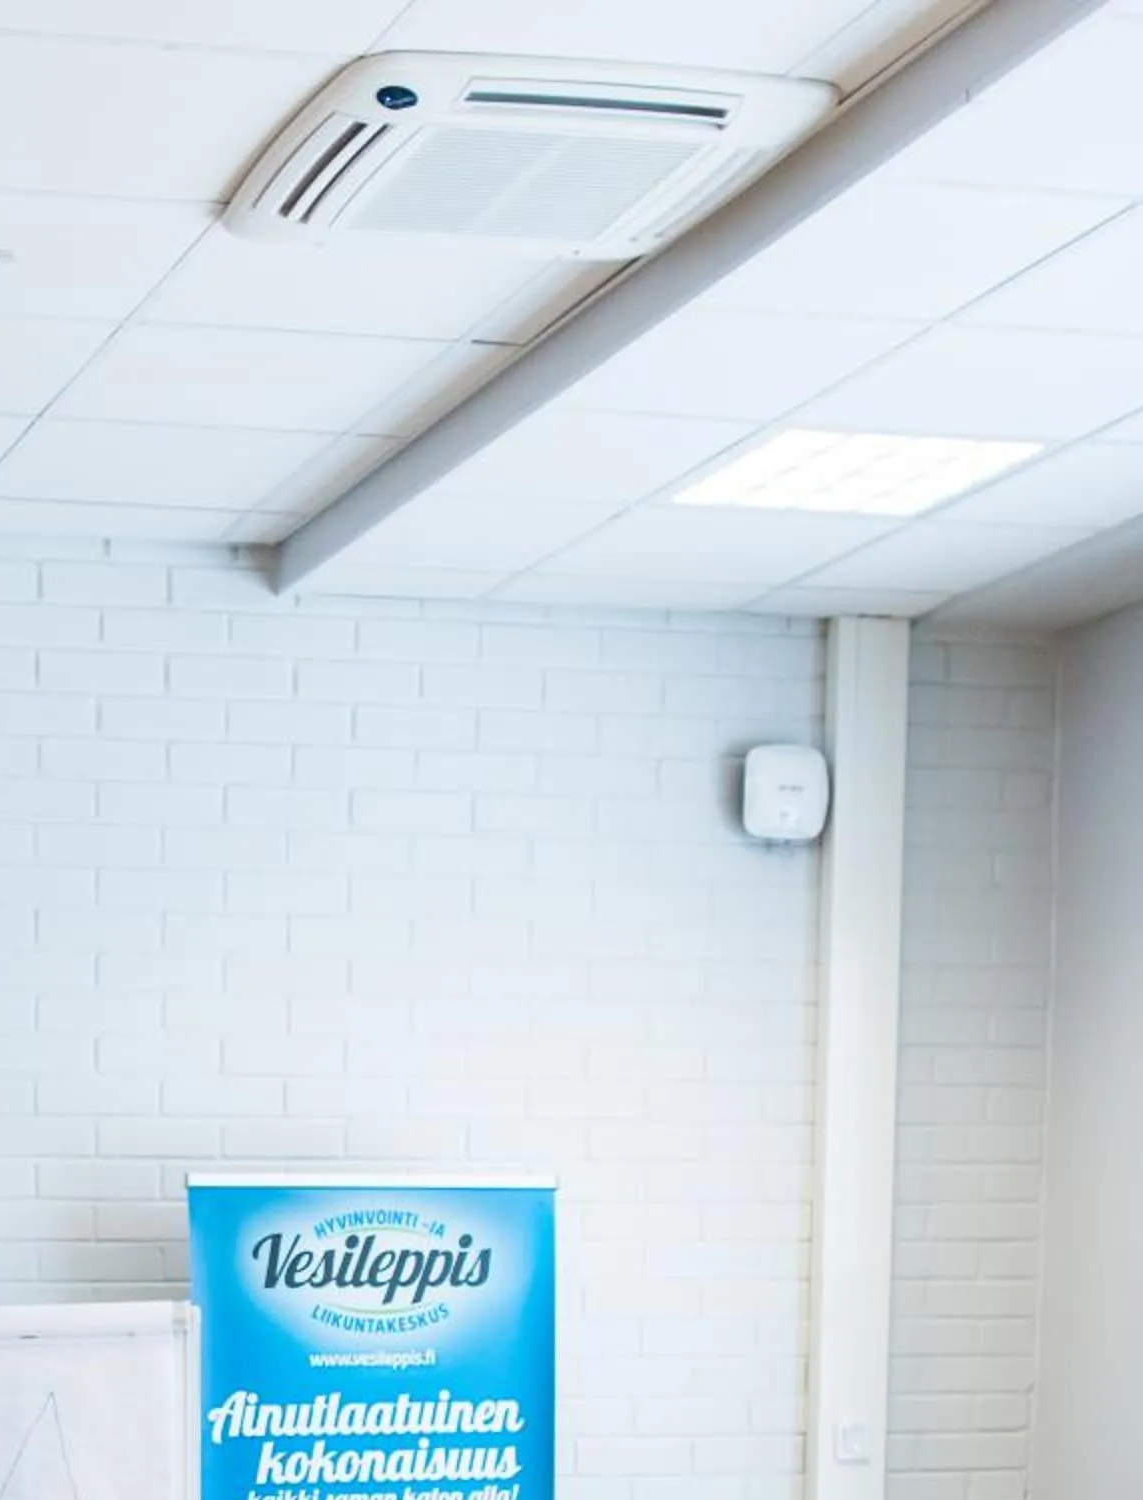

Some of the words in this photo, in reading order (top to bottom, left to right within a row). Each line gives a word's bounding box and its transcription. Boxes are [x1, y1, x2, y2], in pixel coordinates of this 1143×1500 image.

[313, 1209, 419, 1239] HYVINVOINTI
[252, 1233, 492, 1305] Vesileppis
[310, 1302, 451, 1334] LIIKUNTAKESKUS
[308, 1349, 437, 1371] www.vesileppis.fi
[208, 1389, 525, 1444] Ainutlaatuinen
[256, 1437, 522, 1485] kokonaisuus
